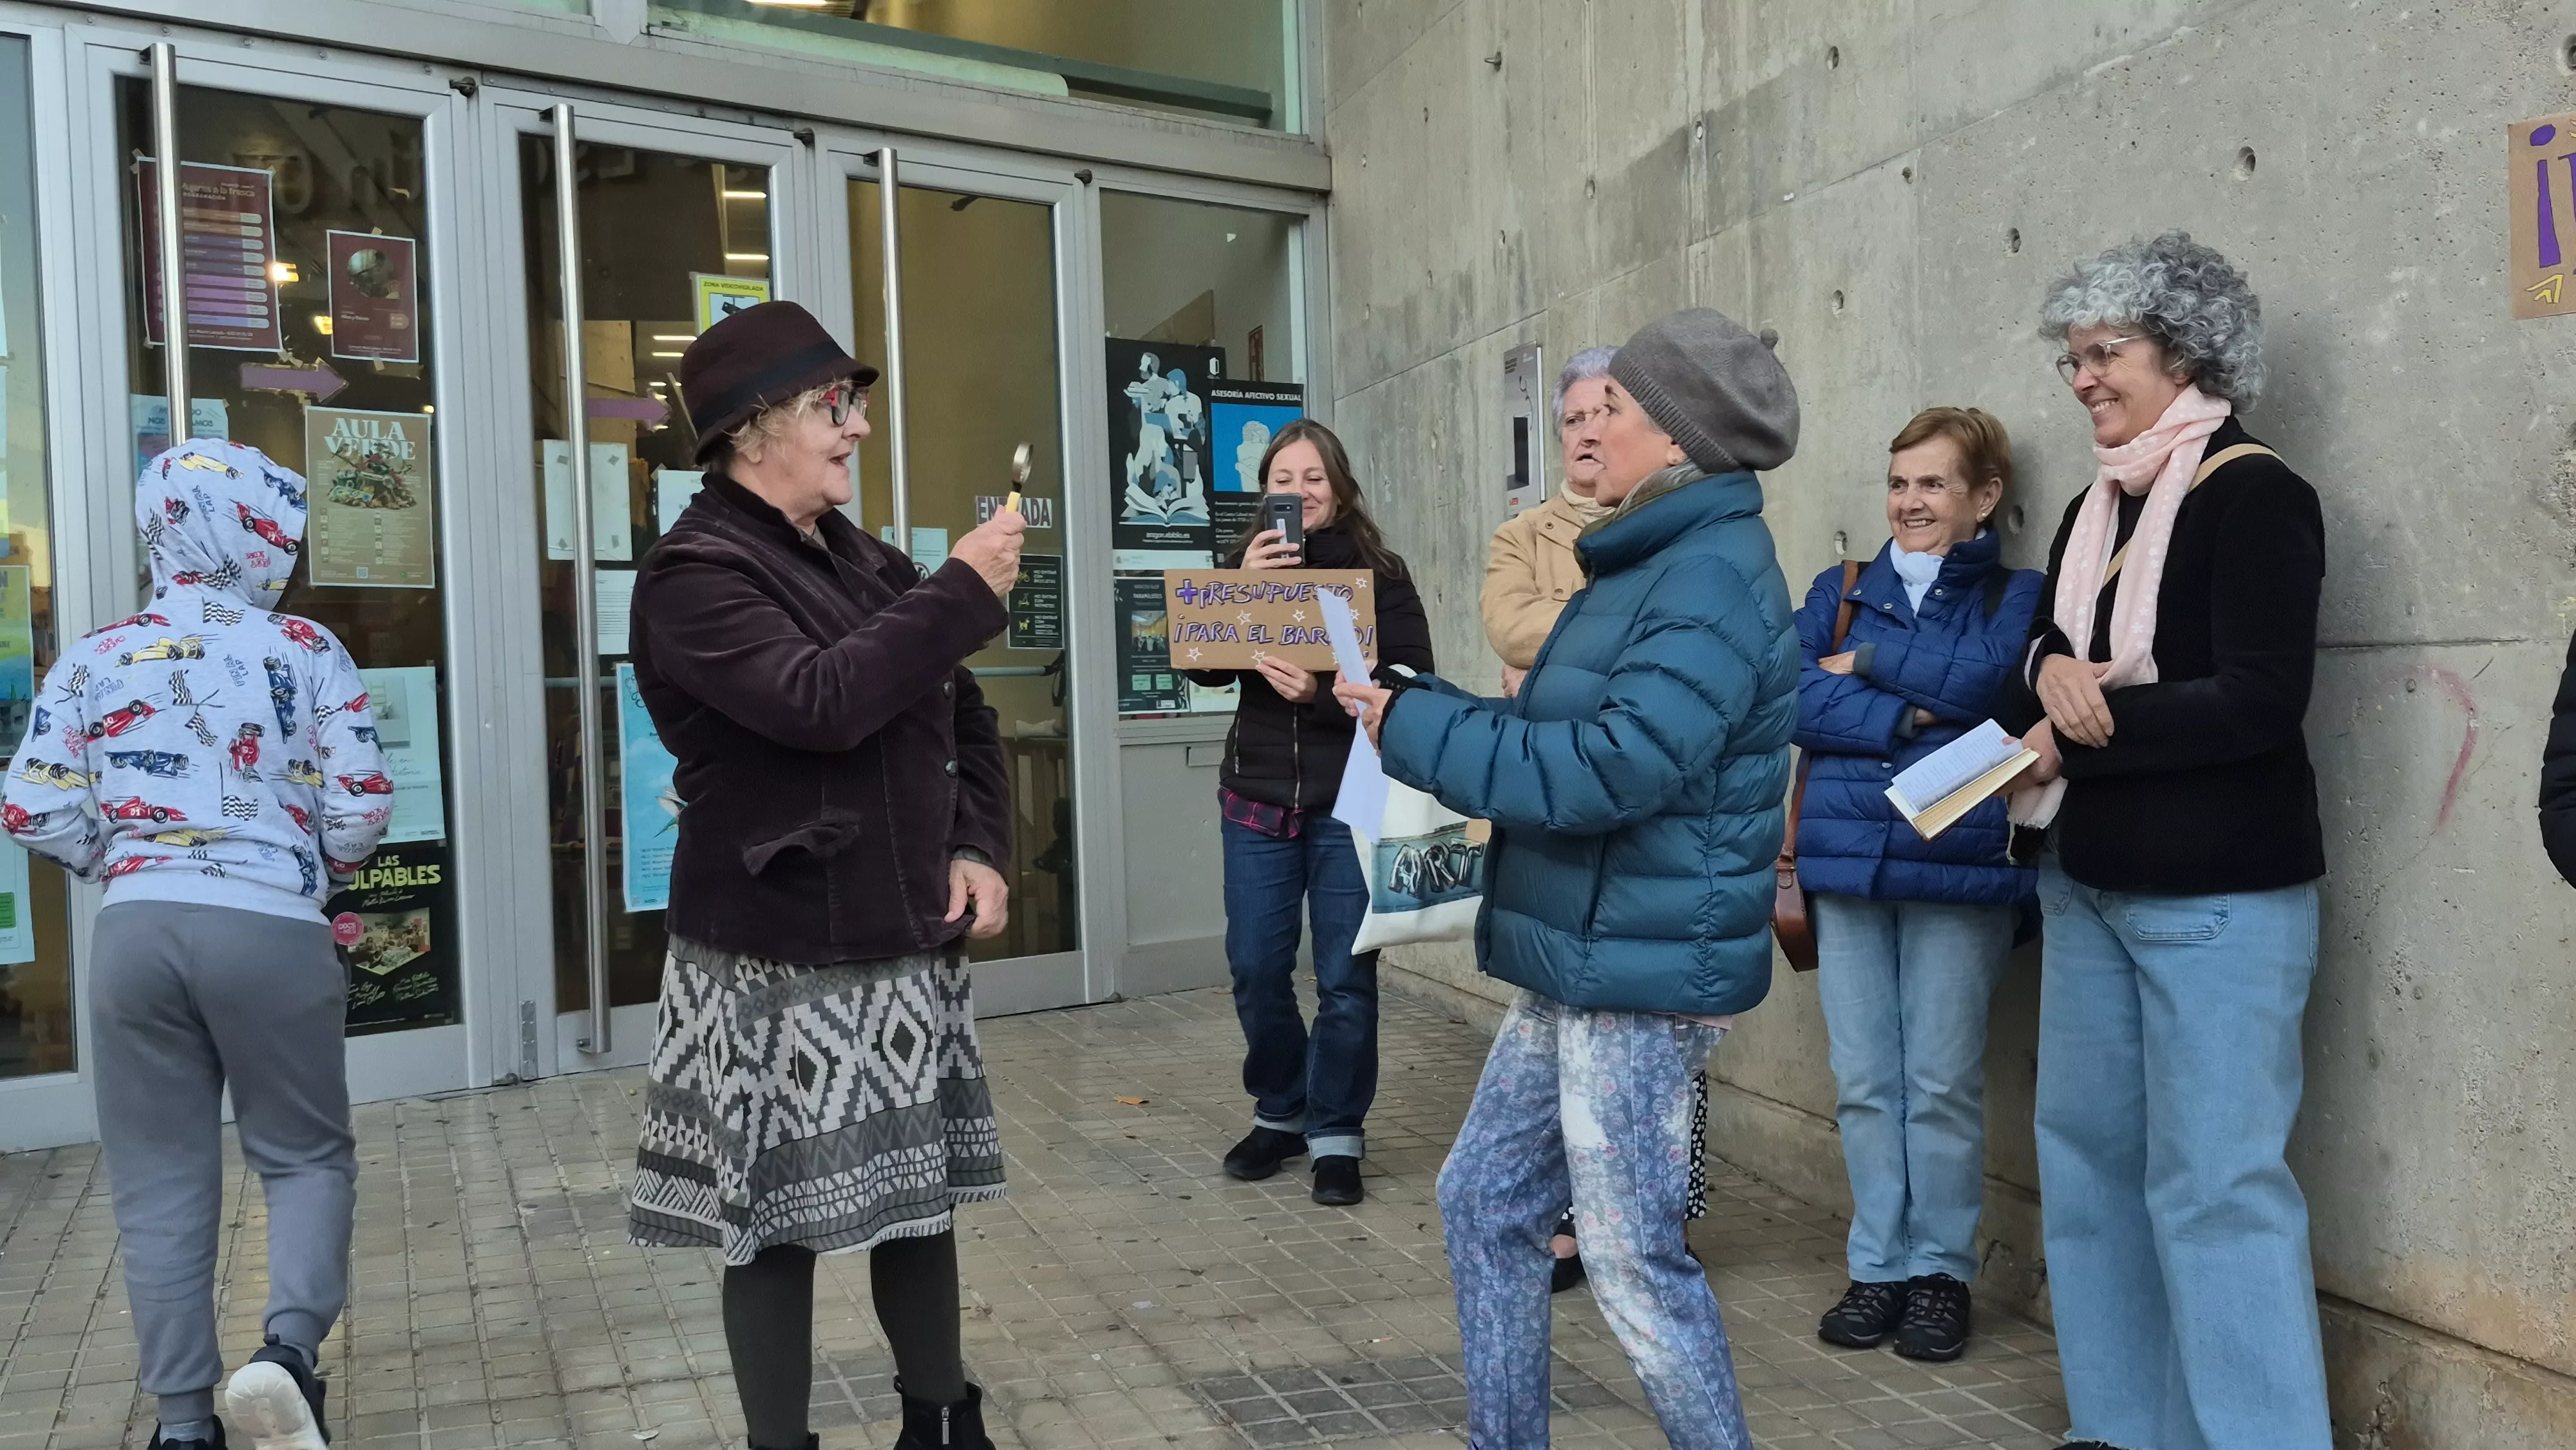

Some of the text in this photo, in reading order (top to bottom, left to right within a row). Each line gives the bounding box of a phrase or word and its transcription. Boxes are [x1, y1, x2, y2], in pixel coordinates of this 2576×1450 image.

[721, 283, 764, 291] VIDEOVIGILADA
[1211, 389, 1244, 398] ASESORÍA
[1244, 391, 1275, 400] AFECTIVO
[331, 417, 407, 440] AULA
[977, 496, 1050, 527] ENADA
[1247, 624, 1274, 644] EL
[1278, 625, 1374, 657] BARO!
[377, 854, 400, 867] LAS
[348, 864, 442, 891] ULPABLES
